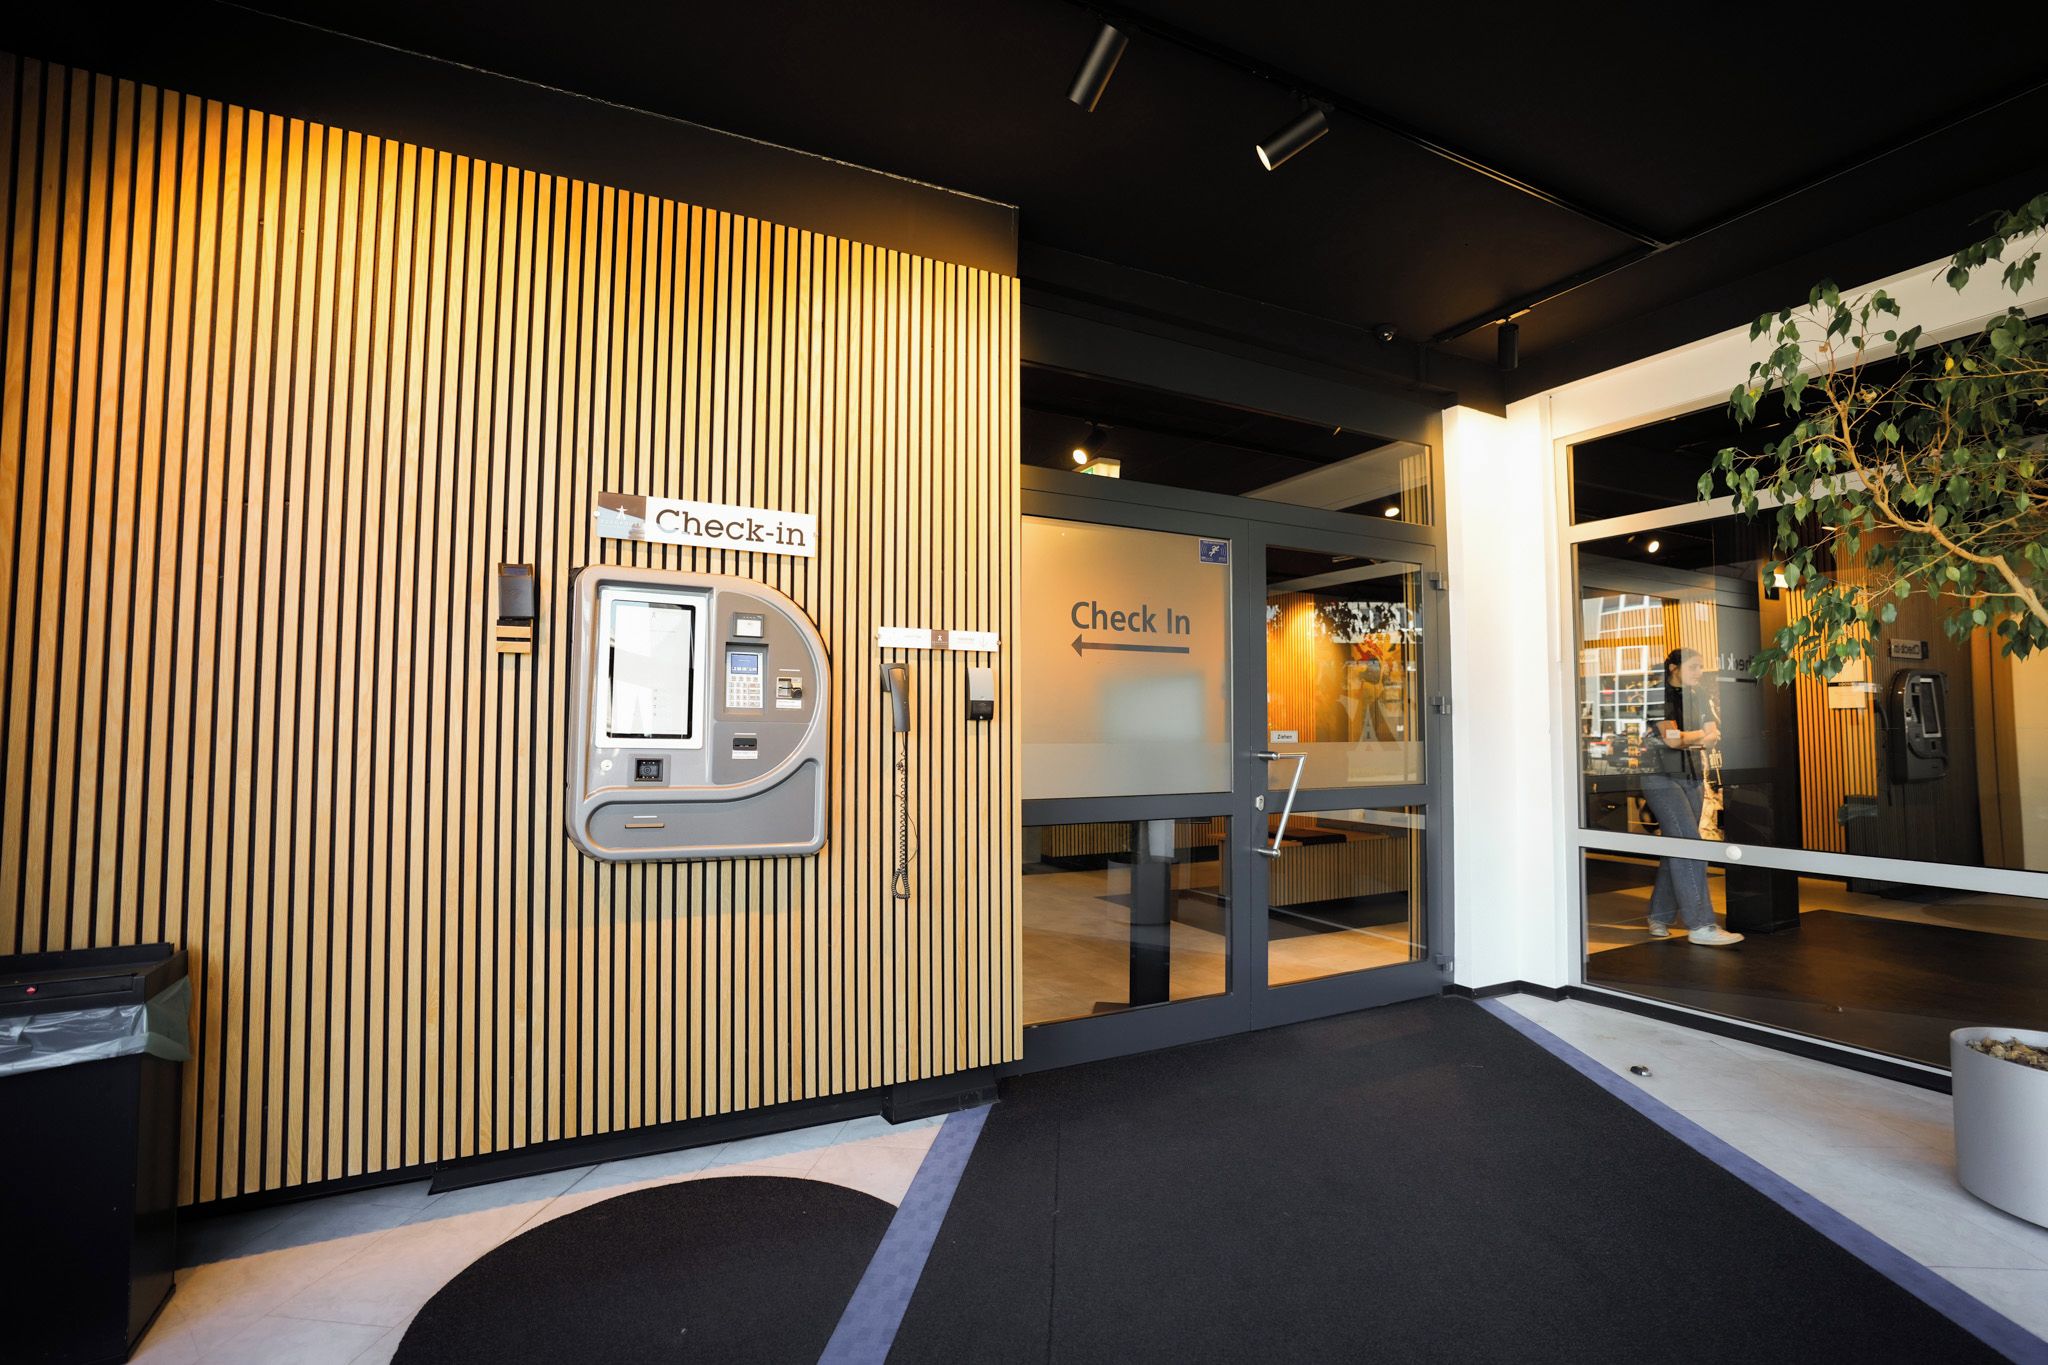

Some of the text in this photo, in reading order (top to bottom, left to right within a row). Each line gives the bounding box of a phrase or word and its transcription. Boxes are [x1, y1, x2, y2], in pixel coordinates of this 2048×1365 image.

[656, 508, 806, 547] Check-in
[1071, 600, 1190, 635] Check In
